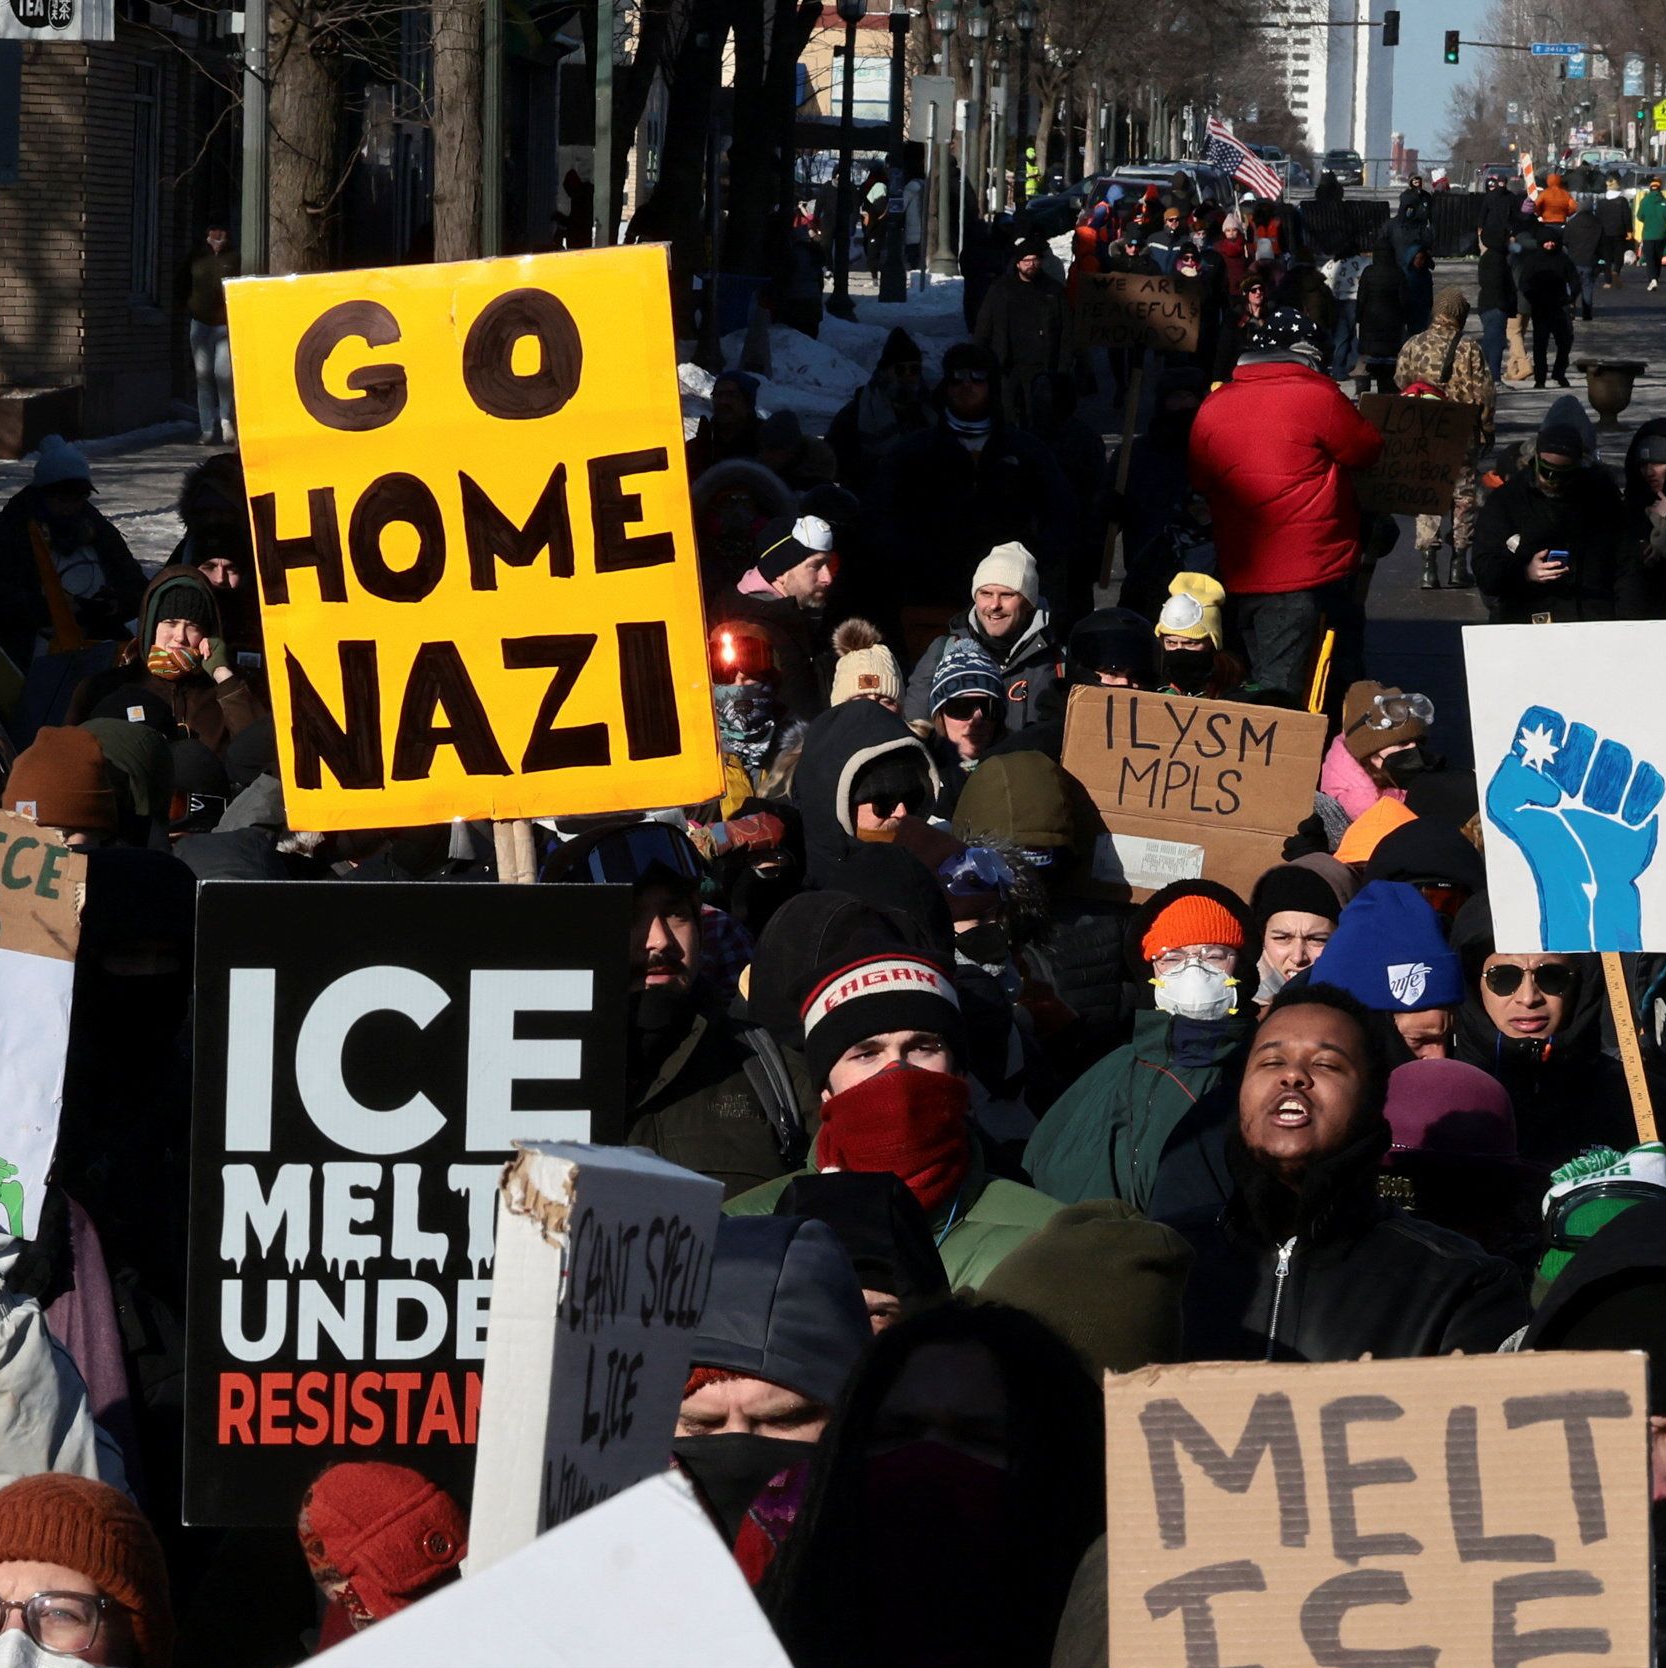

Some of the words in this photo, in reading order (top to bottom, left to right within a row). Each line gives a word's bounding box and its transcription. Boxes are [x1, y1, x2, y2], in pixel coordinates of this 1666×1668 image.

[1092, 278, 1127, 293] WE
[295, 287, 583, 432] GO
[1383, 402, 1456, 439] LOVE
[250, 447, 677, 605] HOME
[285, 620, 681, 790] NAZI
[1106, 695, 1278, 767] ILYSM
[1118, 757, 1243, 815] MPLS
[824, 967, 943, 1011] EAGAN
[223, 965, 594, 1156] ICE
[219, 1279, 495, 1362] UNDE
[1139, 1389, 1632, 1567] MELT
